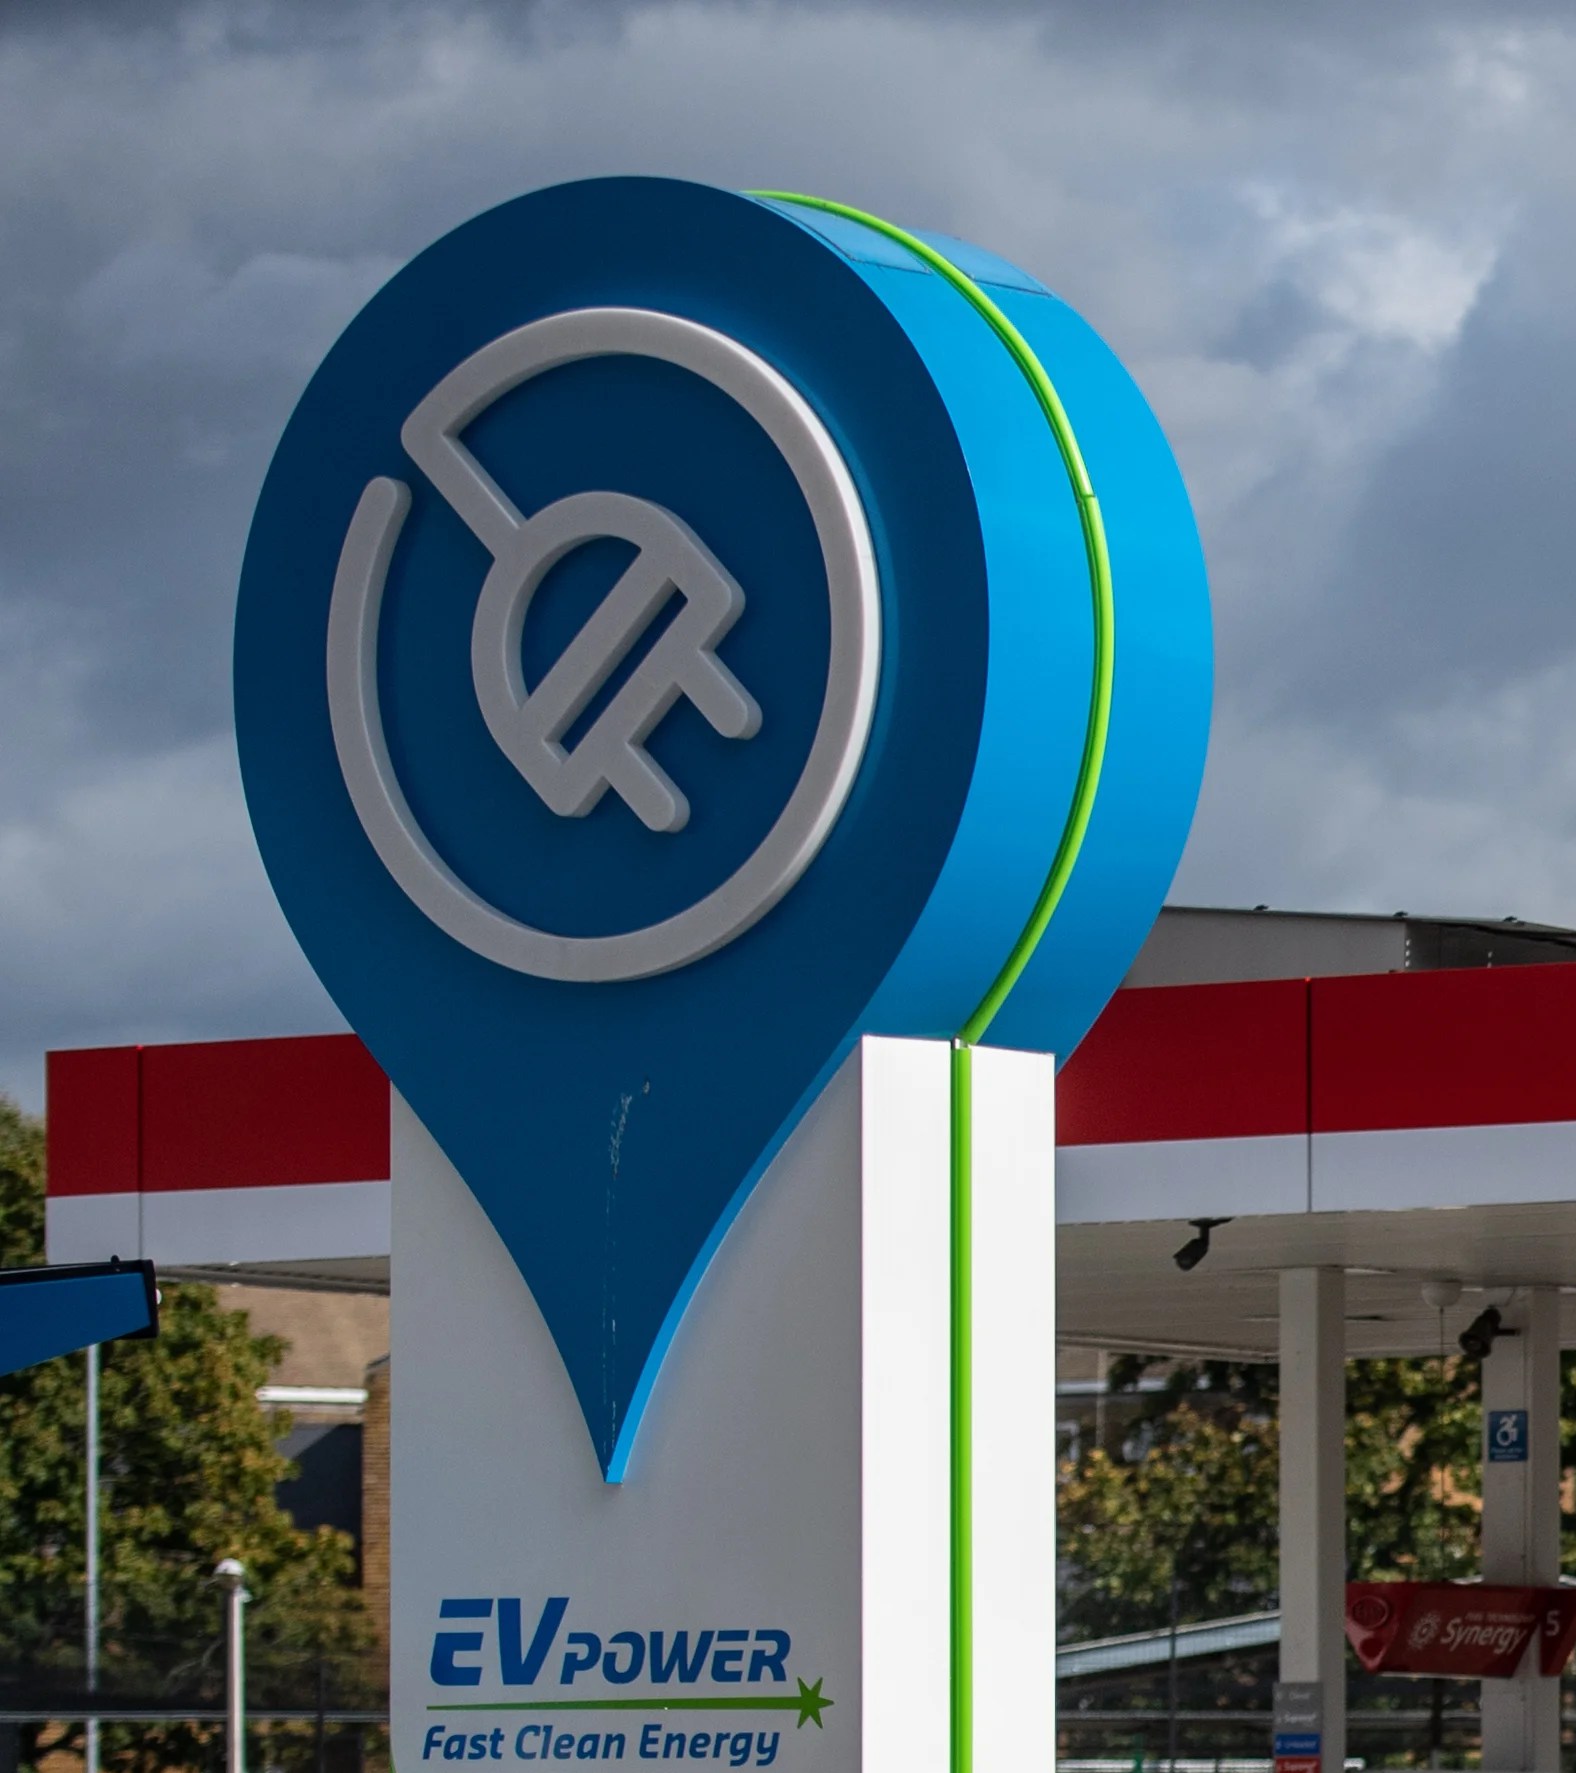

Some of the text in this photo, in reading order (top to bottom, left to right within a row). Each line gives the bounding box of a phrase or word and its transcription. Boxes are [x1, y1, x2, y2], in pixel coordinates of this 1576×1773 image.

[1441, 1620, 1528, 1654] Synergy
[1545, 1609, 1560, 1636] 5
[422, 1724, 781, 1767] Fast Clean Energy
